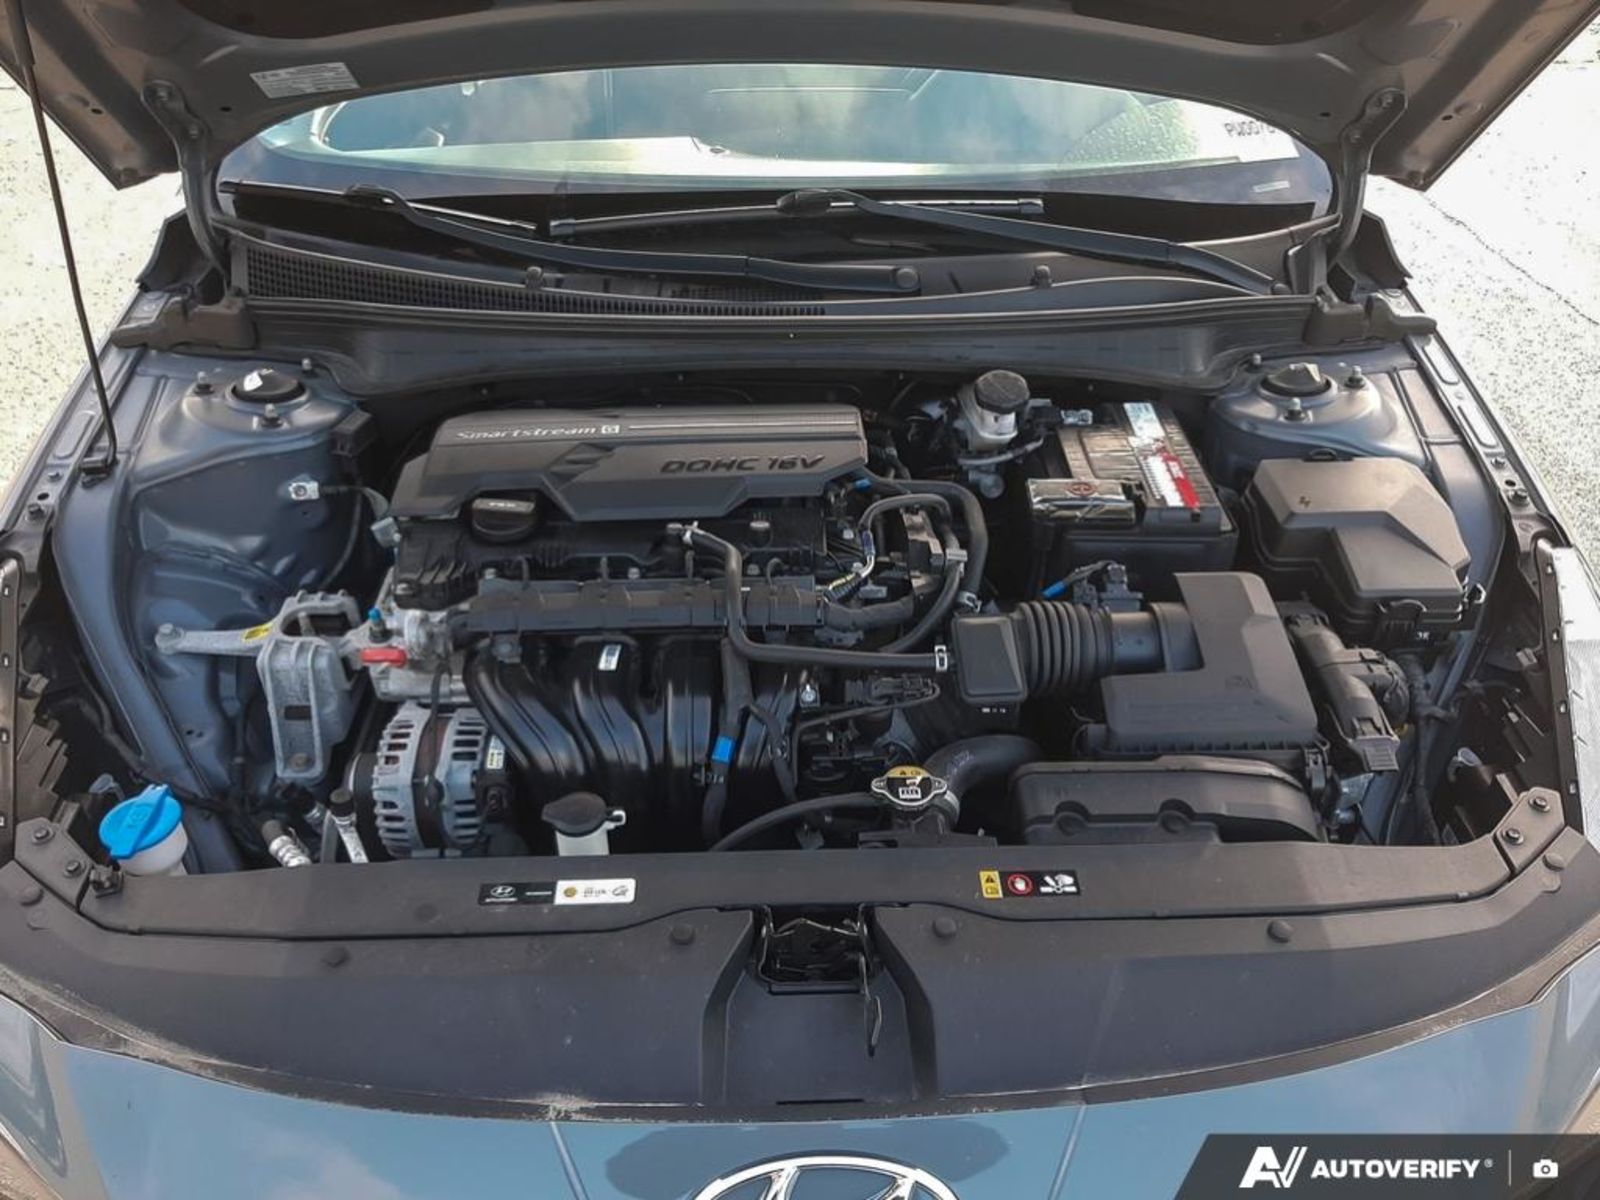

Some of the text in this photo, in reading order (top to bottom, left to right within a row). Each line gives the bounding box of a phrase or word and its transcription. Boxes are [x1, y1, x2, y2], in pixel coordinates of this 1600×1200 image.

[456, 425, 597, 440] Smartstream
[660, 454, 826, 474] DOHC 16V
